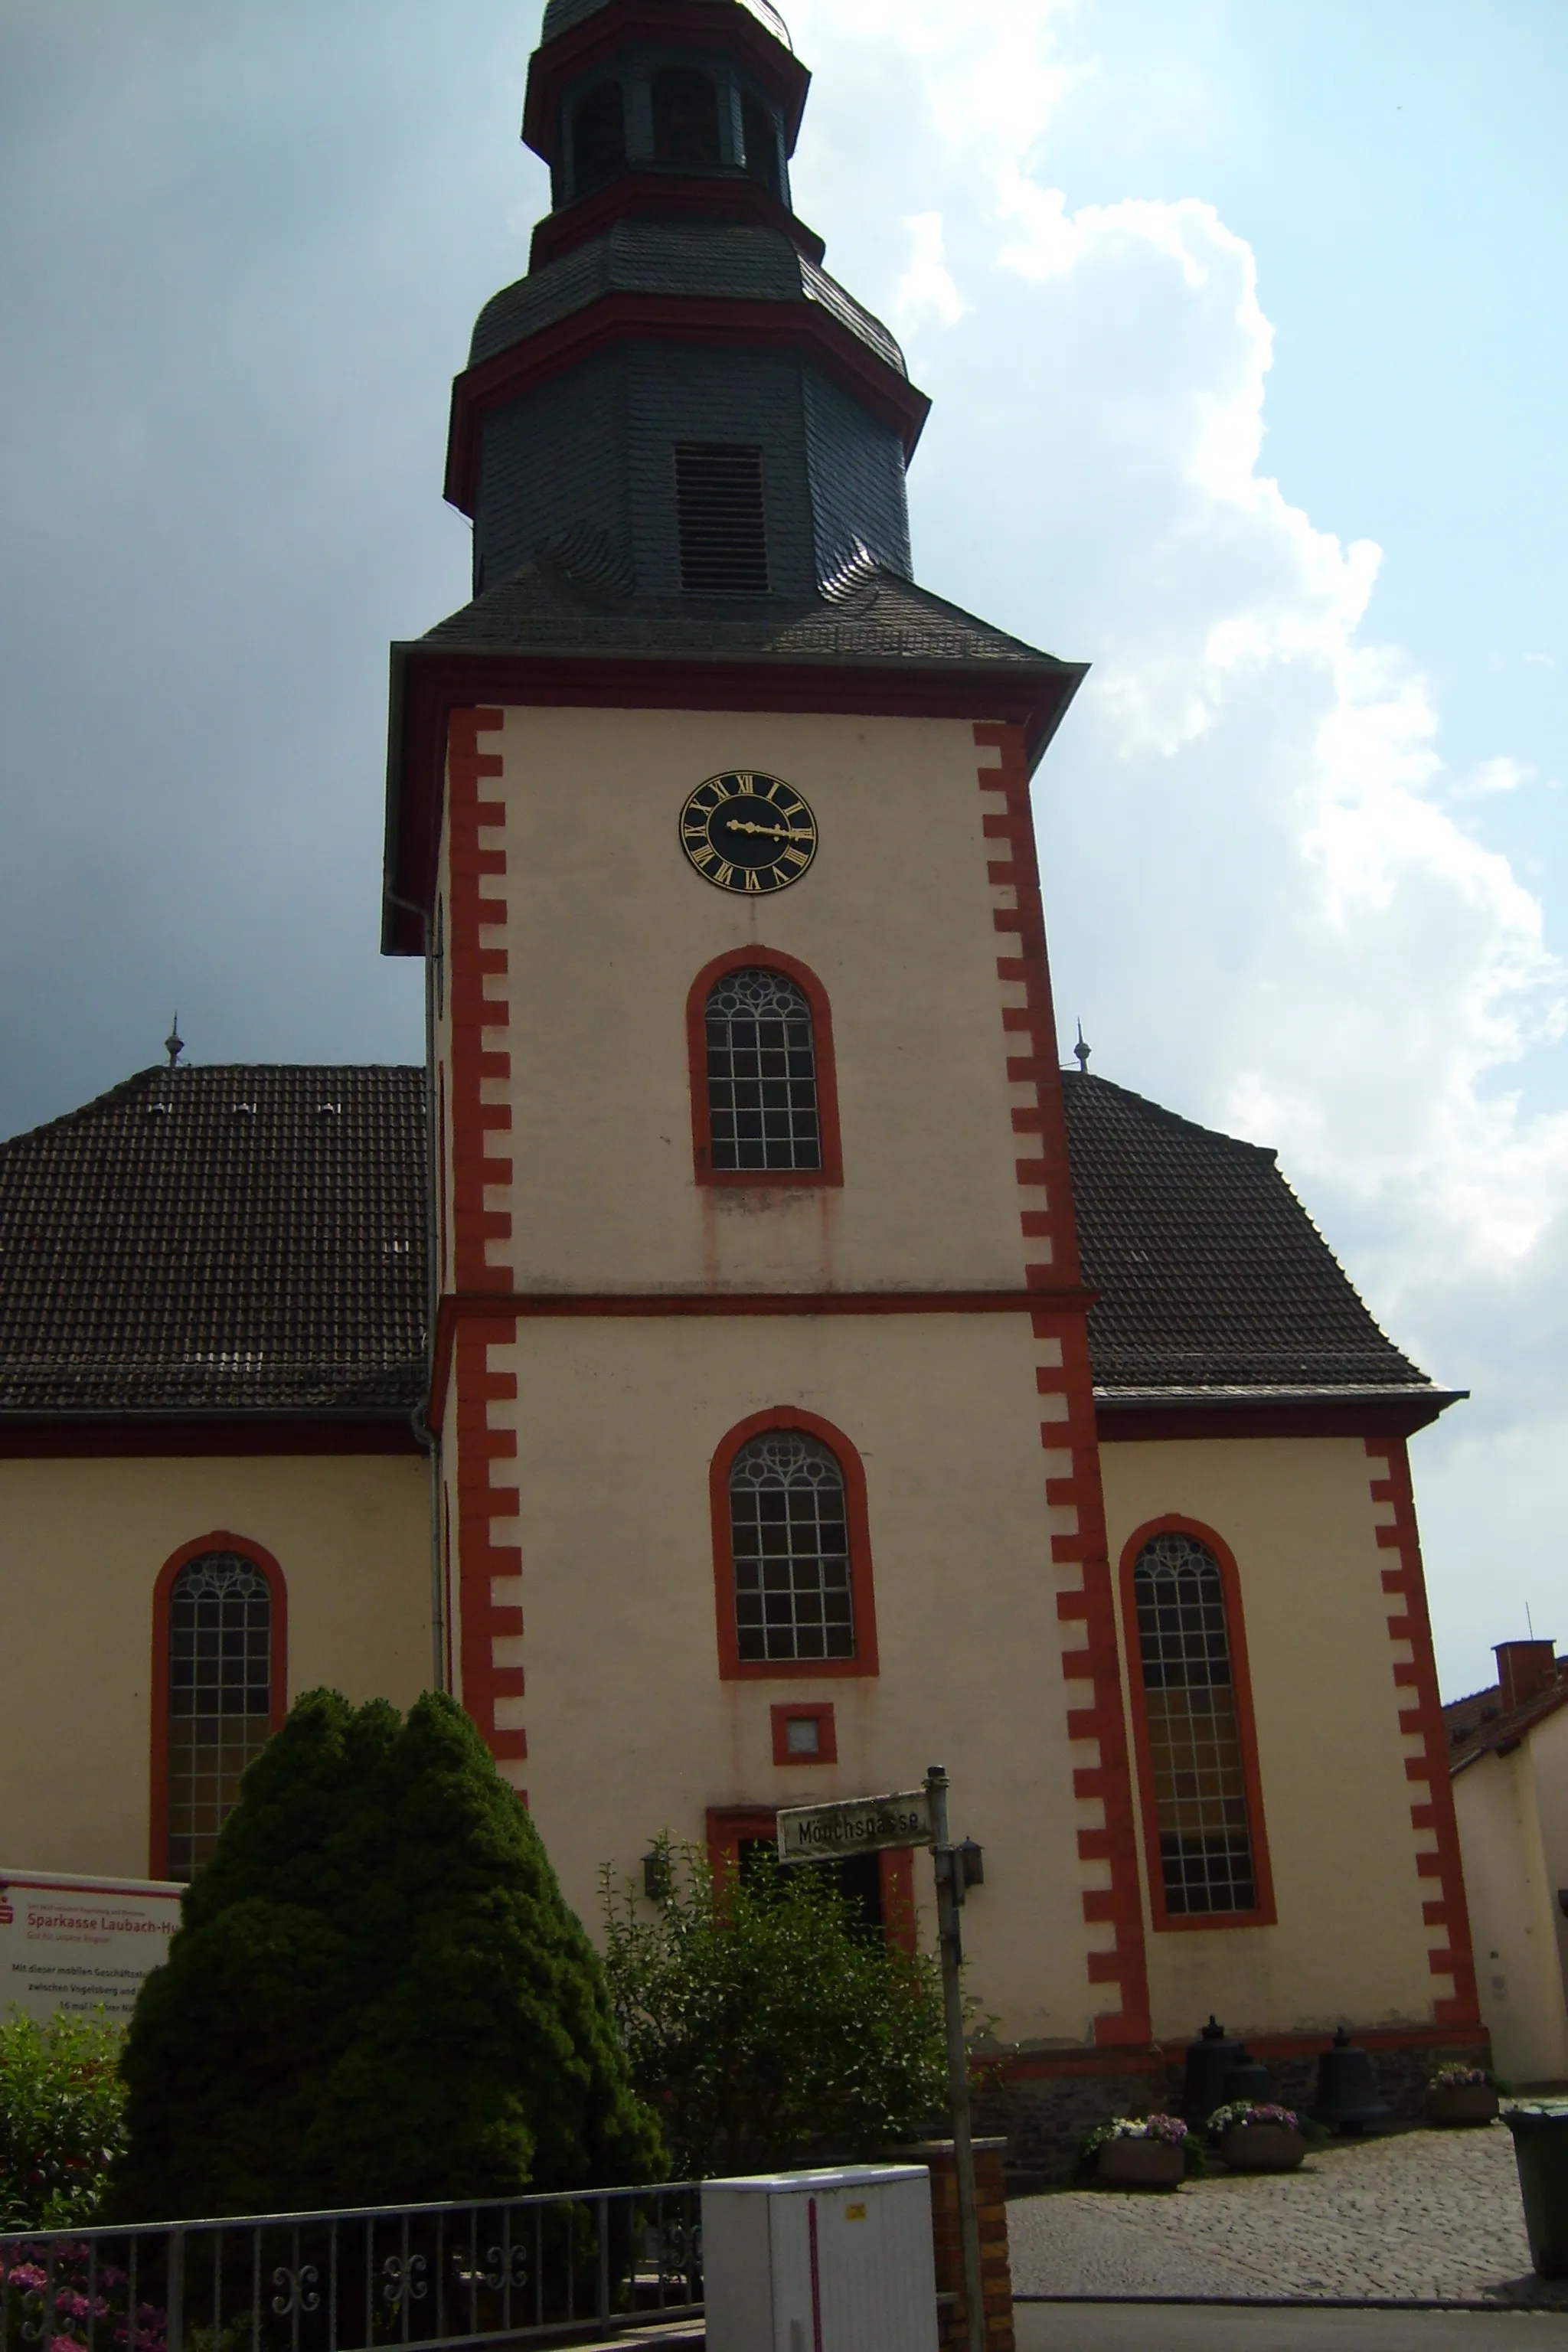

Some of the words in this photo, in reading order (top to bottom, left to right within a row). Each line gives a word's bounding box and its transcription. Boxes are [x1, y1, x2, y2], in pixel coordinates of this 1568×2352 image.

[707, 780, 731, 802] XI
[737, 775, 754, 794] XII
[766, 782, 780, 801] I
[689, 798, 713, 815] X
[783, 800, 805, 815] II
[799, 1813, 918, 1845] Mönchsgasse
[28, 1913, 97, 1930] Sparkasse
[101, 1917, 179, 1934] Laubach-Hu
[93, 1968, 147, 1978] Geschäftsst
